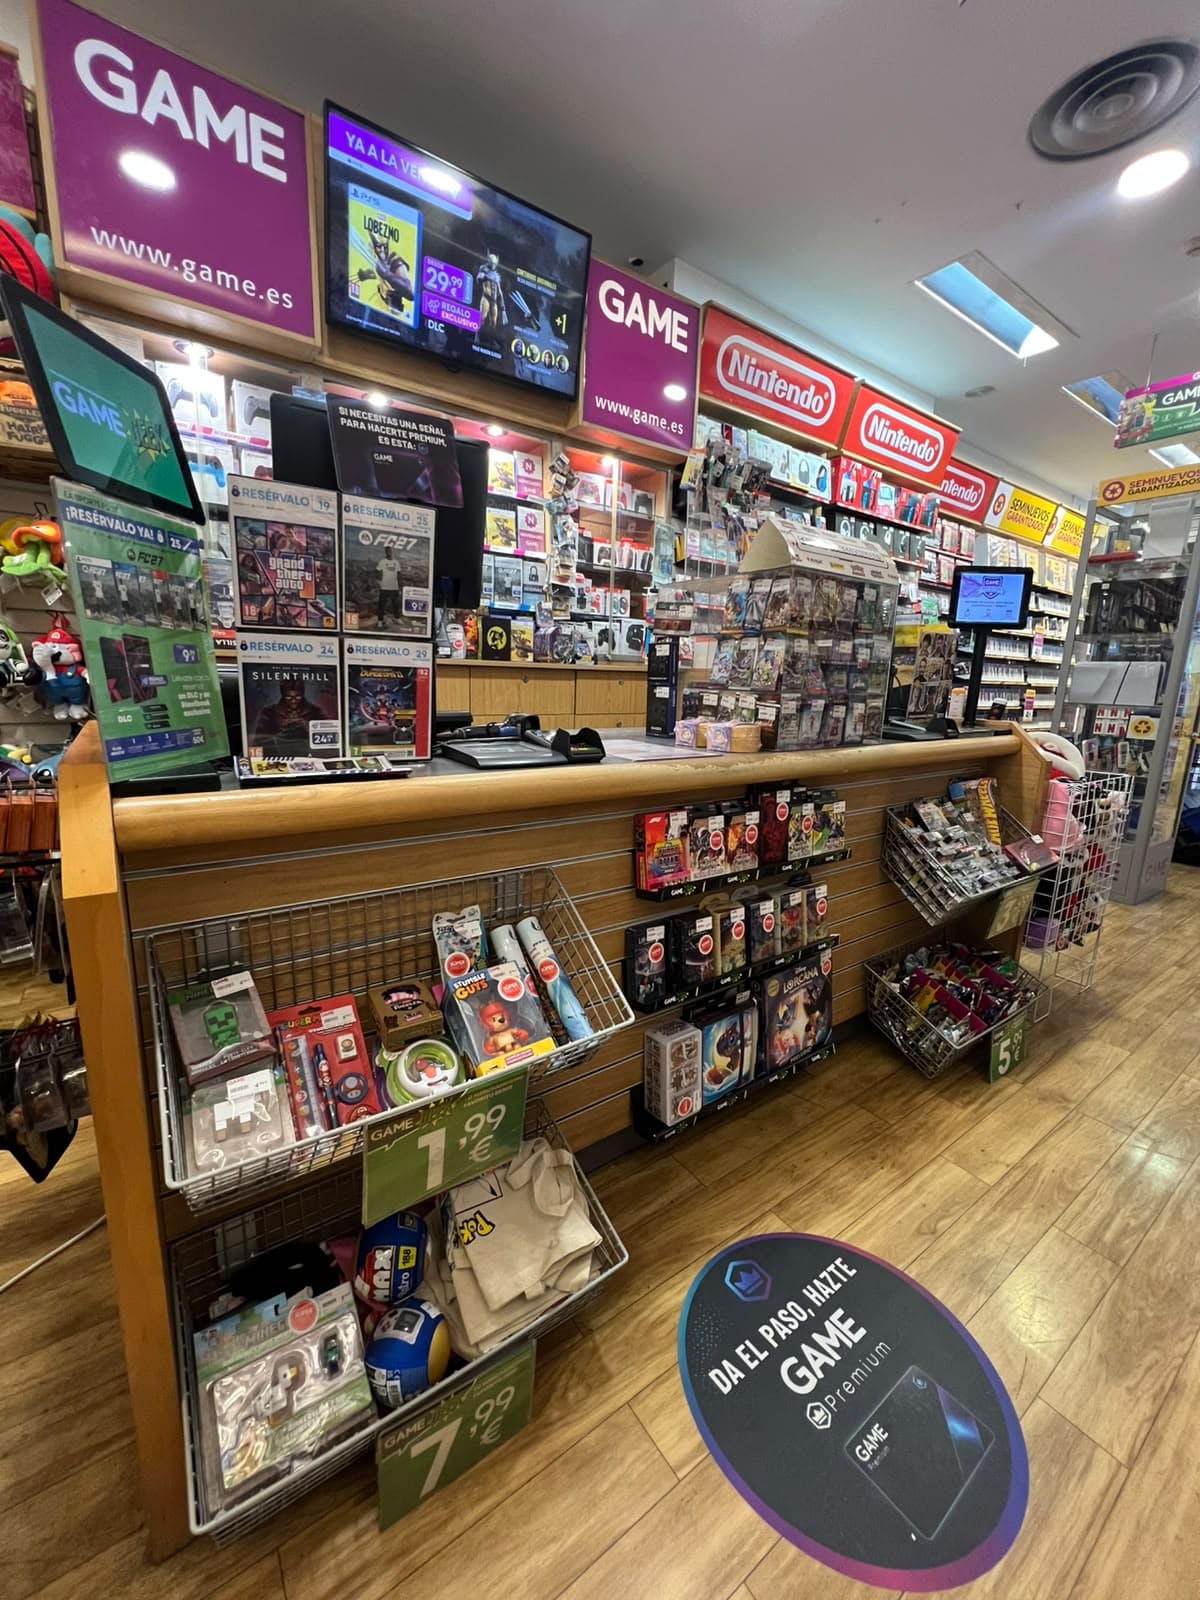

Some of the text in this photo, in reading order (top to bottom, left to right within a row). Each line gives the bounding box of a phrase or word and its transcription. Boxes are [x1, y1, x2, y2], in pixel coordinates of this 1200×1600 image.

[74, 38, 287, 183] GAME
[345, 131, 398, 170] YA A LA
[363, 215, 399, 243] LOBEZNO
[91, 226, 293, 309] www.game.es
[440, 311, 479, 330] EXCLUSIVO
[441, 300, 471, 319] REGALO
[598, 280, 689, 354] GAME
[427, 319, 445, 334] DLC
[728, 349, 825, 415] Nintendo
[52, 381, 126, 438] GAME
[338, 406, 446, 438] SI NECESITAS UNA SEÑAL
[595, 395, 685, 436] www.game.es
[340, 417, 367, 431] PARA
[368, 423, 408, 440] HACERTE
[378, 435, 390, 446] ES
[868, 413, 935, 463] Nintendo
[242, 486, 330, 511] RESÉRVALO 19
[940, 478, 979, 504] ntendo
[352, 502, 410, 522] RESÉRVALO
[1010, 497, 1051, 523] SEMINUEVOS
[137, 525, 154, 541] YA!
[373, 532, 418, 551] FC27
[137, 551, 164, 567] FC27
[268, 557, 305, 570] grand
[275, 577, 304, 590] auto
[276, 567, 312, 581] theft
[249, 640, 314, 653] RESÉRVALO
[355, 644, 427, 658] RESÉRVALO 29
[252, 671, 329, 681] SILENT HILL
[453, 972, 486, 989] STUMBLE
[455, 979, 488, 999] GUYS
[783, 966, 819, 994] LORCANA
[370, 1118, 414, 1142] GAME
[468, 1135, 494, 1162] €
[459, 1209, 496, 1245] POK
[708, 1256, 858, 1395] DA EL PASO, HAZTE
[780, 1307, 867, 1395] GAME
[824, 1341, 892, 1413] Premium
[384, 1418, 427, 1449] GAME
[480, 1415, 503, 1446] €
[855, 1423, 889, 1462] GAME
